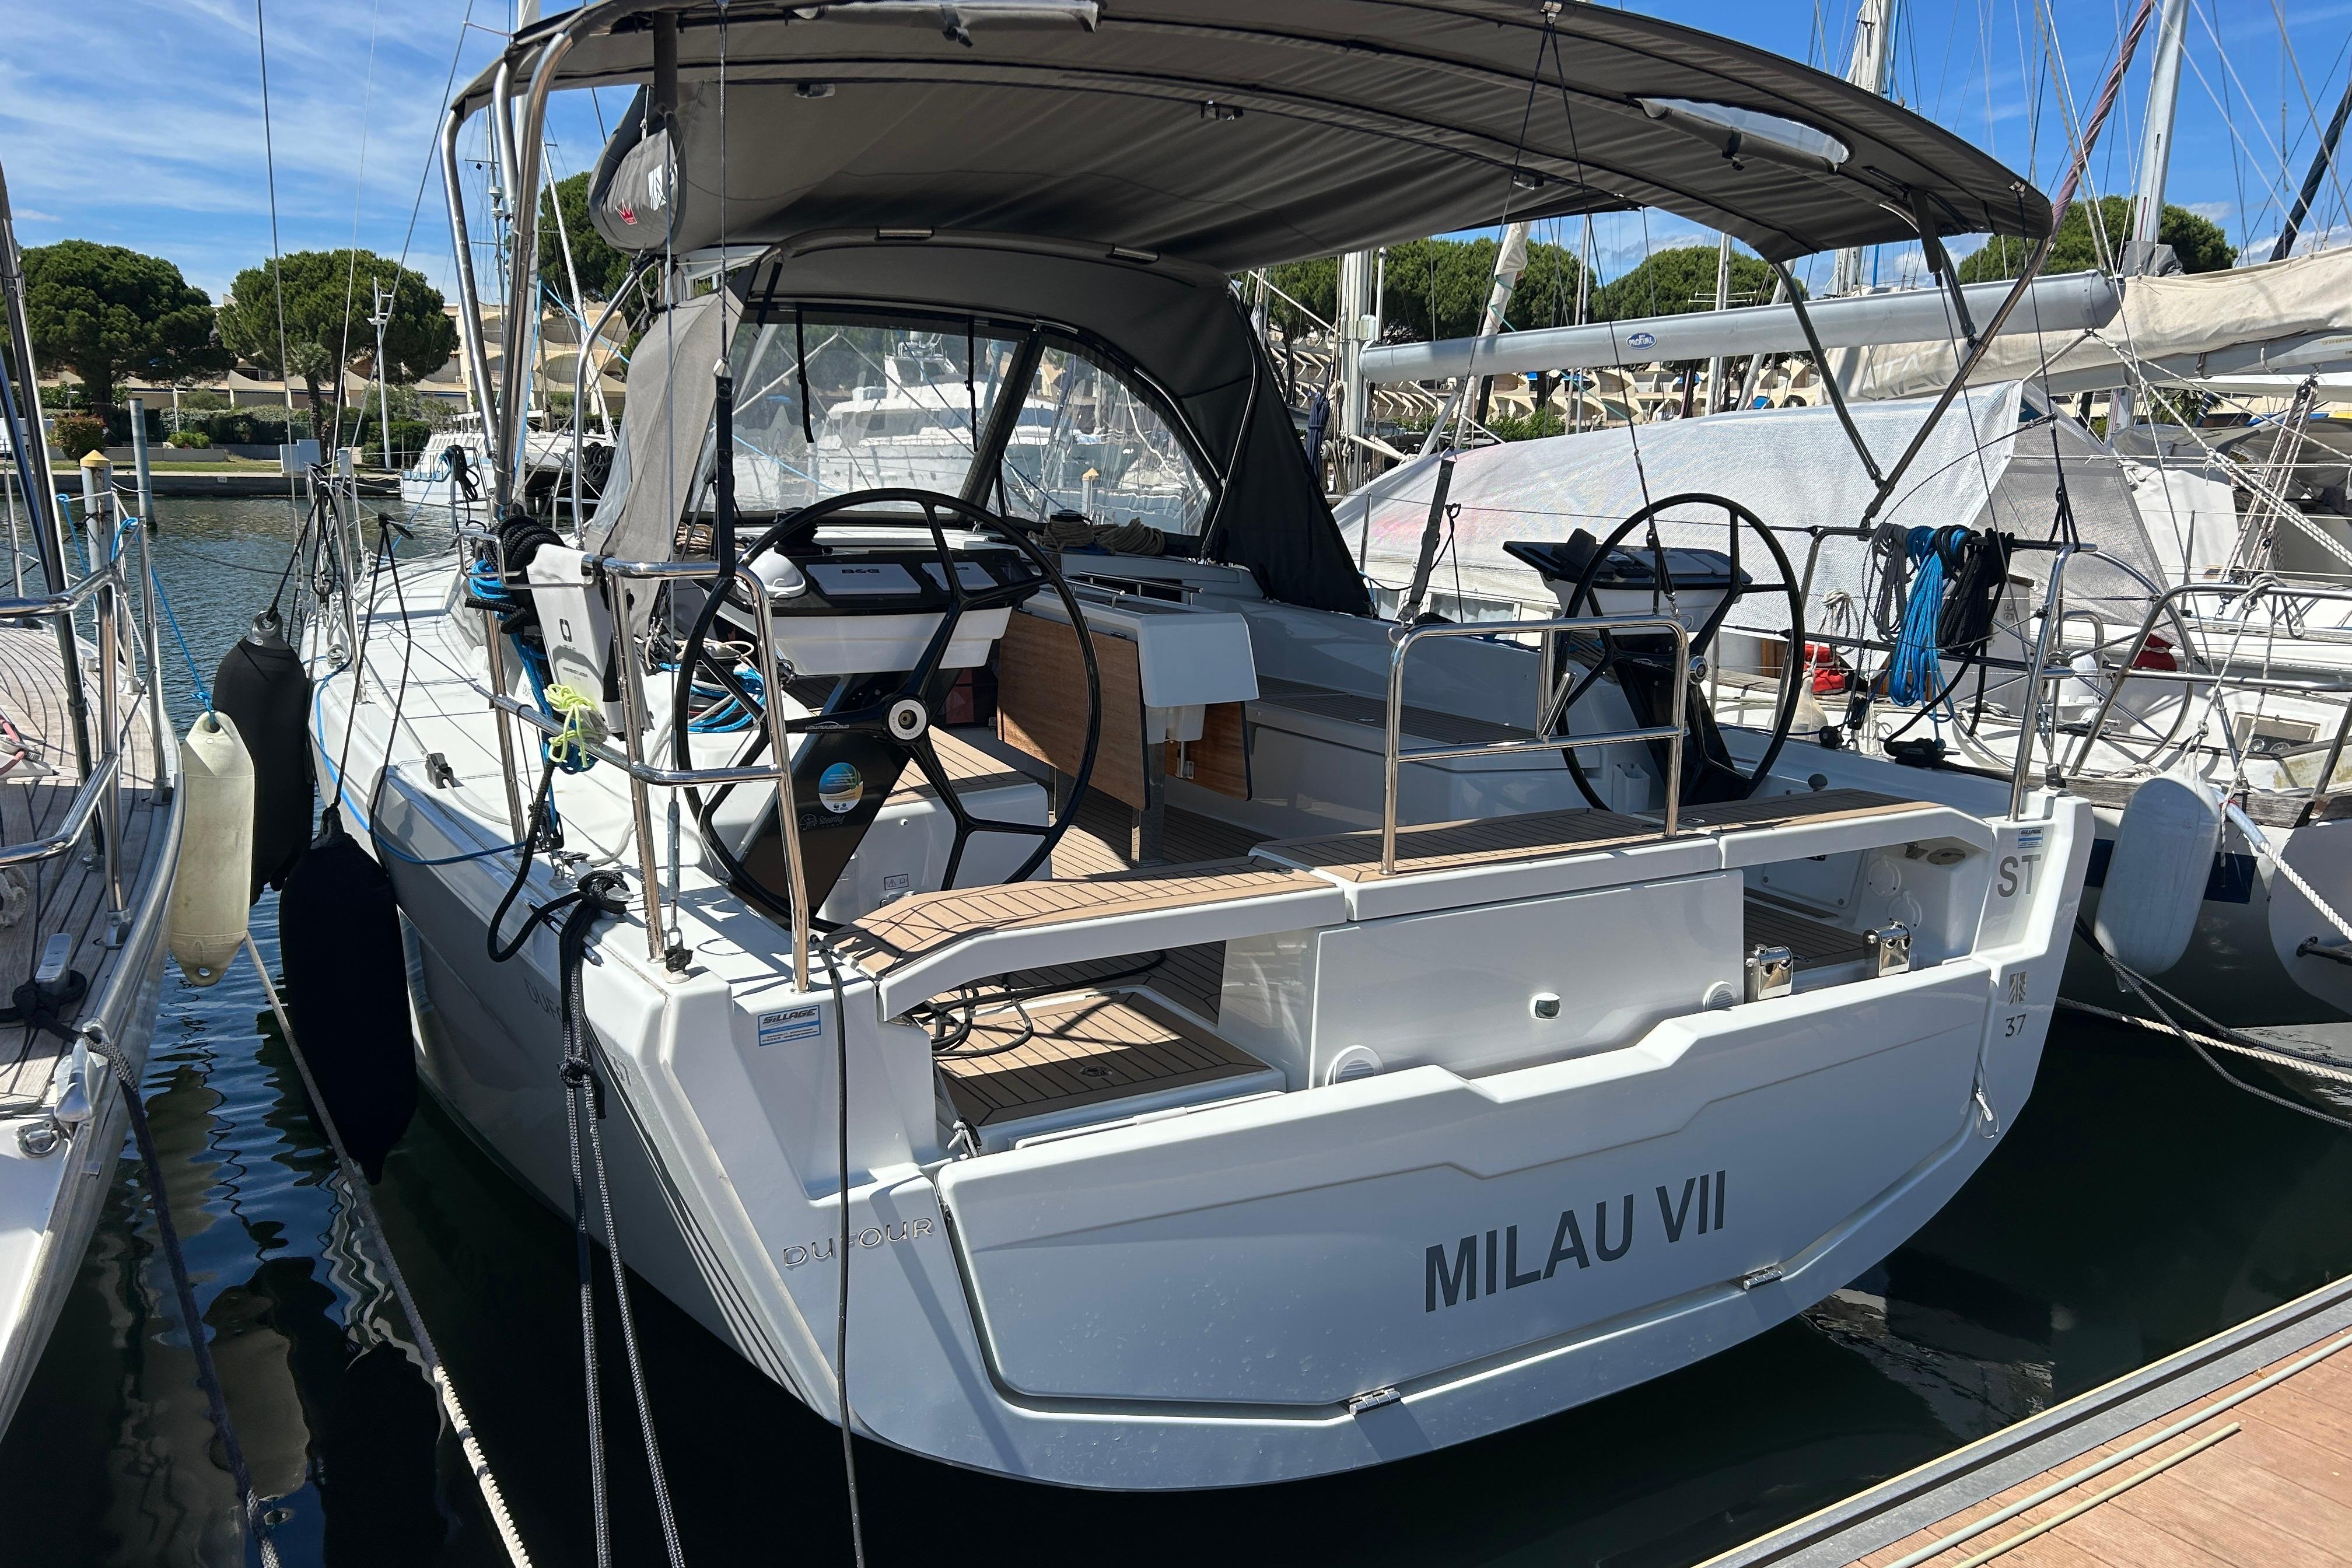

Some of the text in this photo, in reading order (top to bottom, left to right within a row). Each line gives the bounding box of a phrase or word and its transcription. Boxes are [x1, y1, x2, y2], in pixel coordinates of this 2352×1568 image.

[1997, 853, 2041, 898] ST
[2005, 1013, 2027, 1037] 37
[1425, 1170, 1726, 1313] MILAU VII
